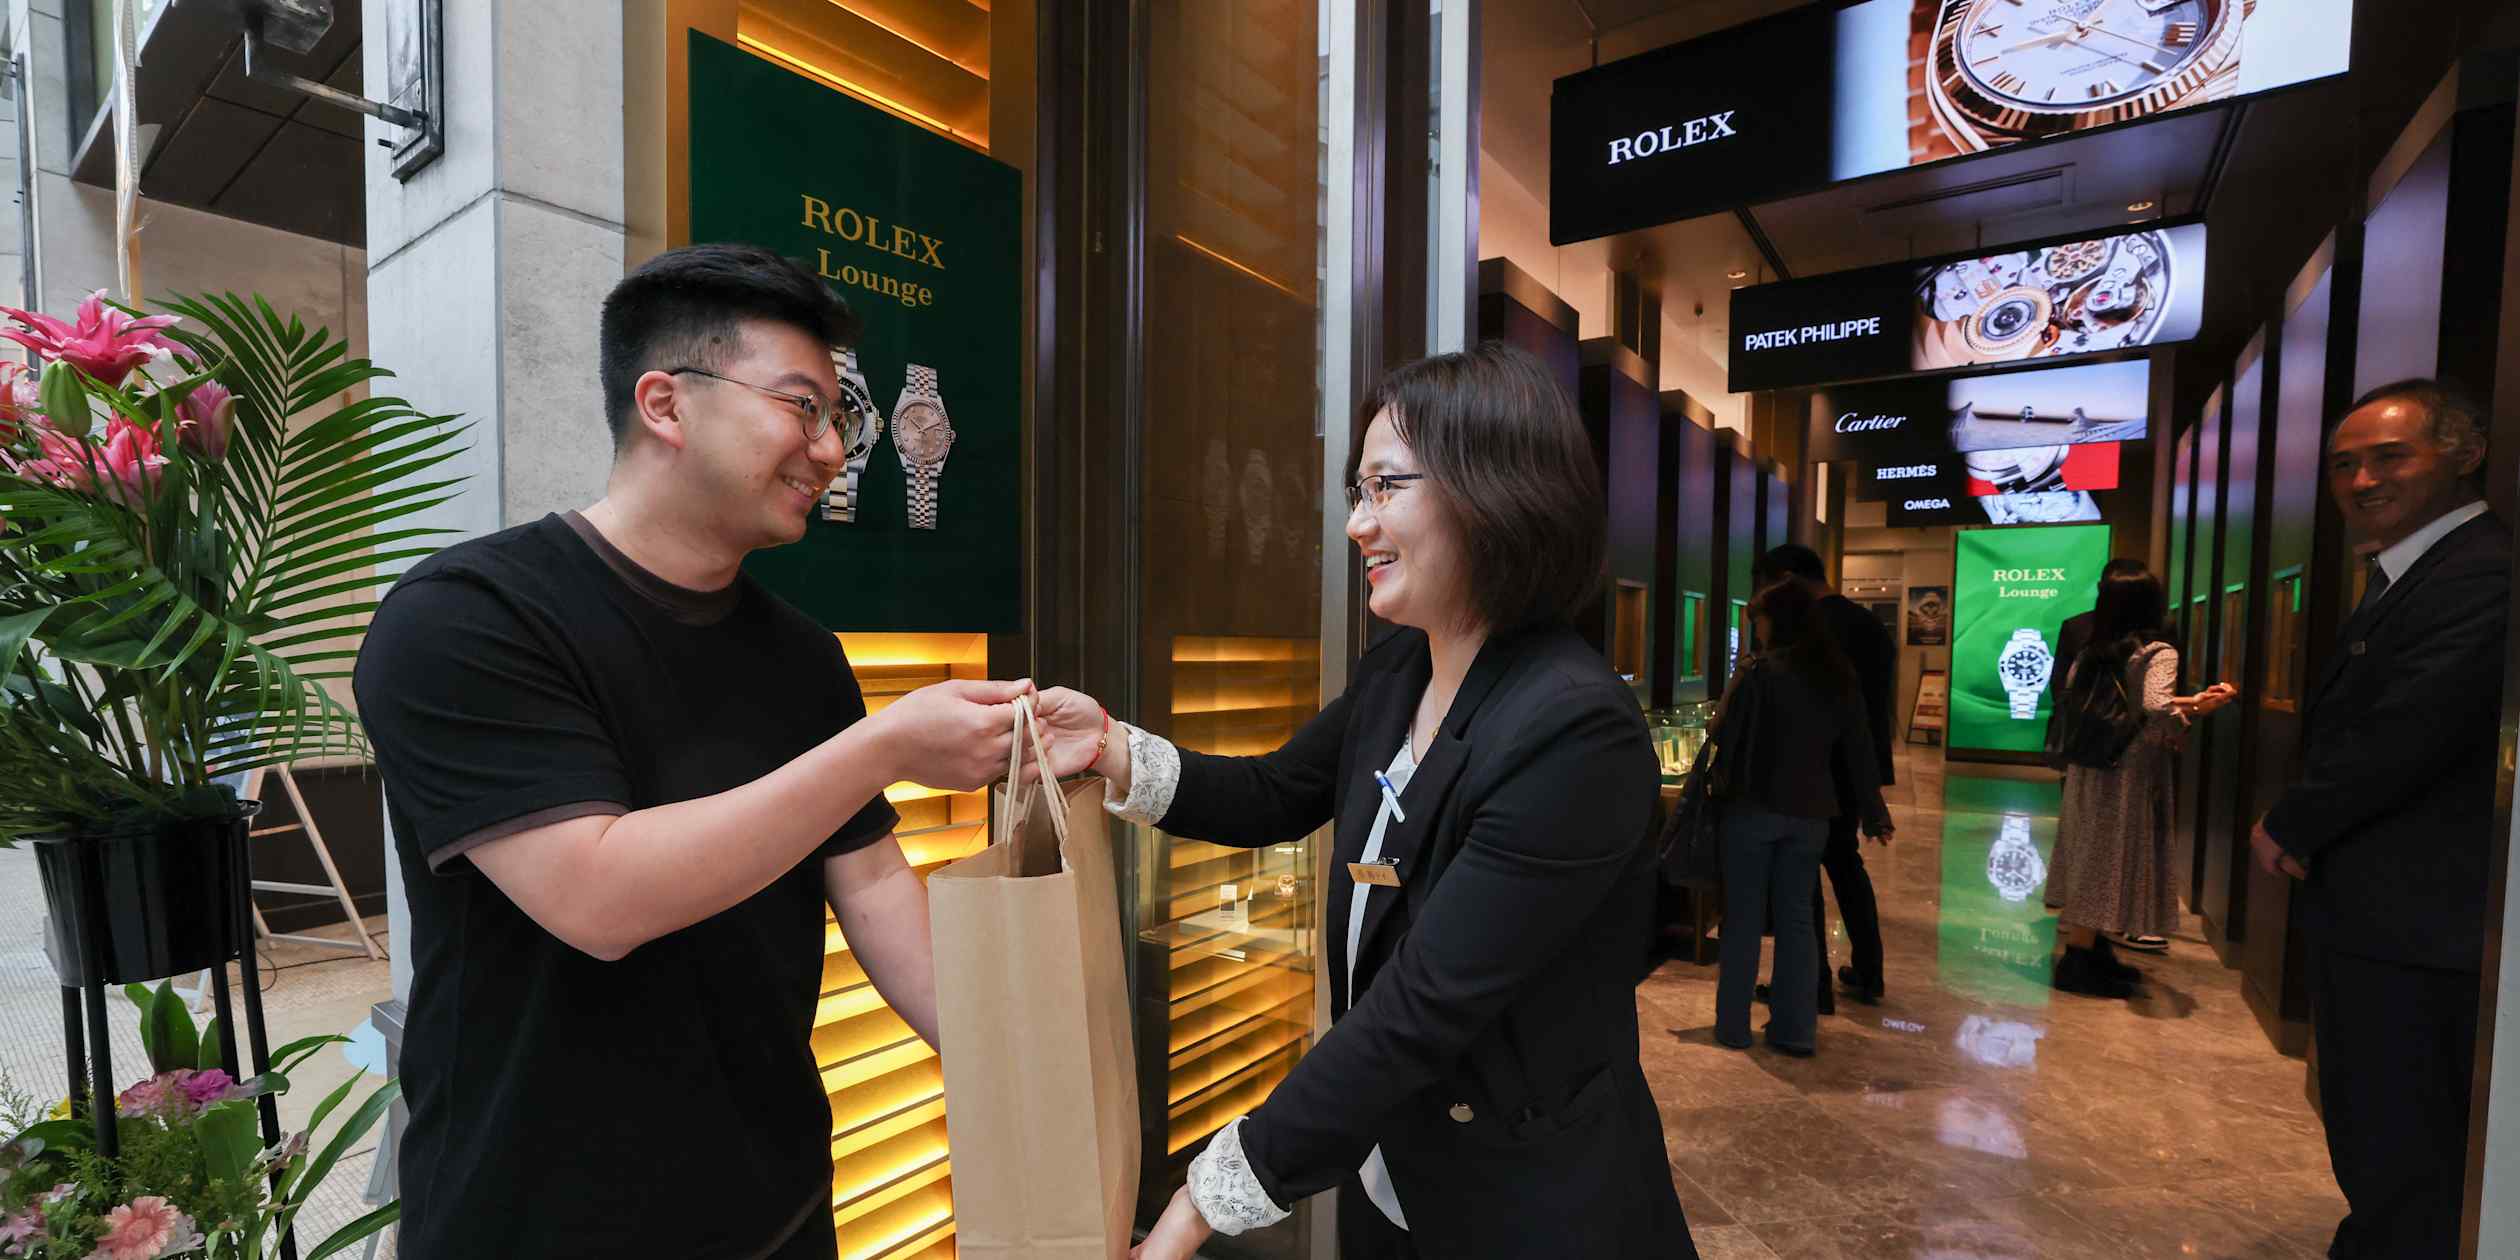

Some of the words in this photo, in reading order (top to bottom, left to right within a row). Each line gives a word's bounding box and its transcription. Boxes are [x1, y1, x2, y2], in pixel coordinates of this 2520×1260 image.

[1608, 110, 1736, 165] ROLEX
[801, 194, 945, 270] ROLEX
[817, 247, 932, 308] Lounge
[1745, 328, 1798, 352] PATEK
[1800, 316, 1881, 344] PHILIPPE
[1835, 412, 1906, 433] Cartier
[1904, 498, 1951, 511] OMEGA
[1993, 568, 2066, 582] ROLEX
[1999, 586, 2059, 600] Lounge
